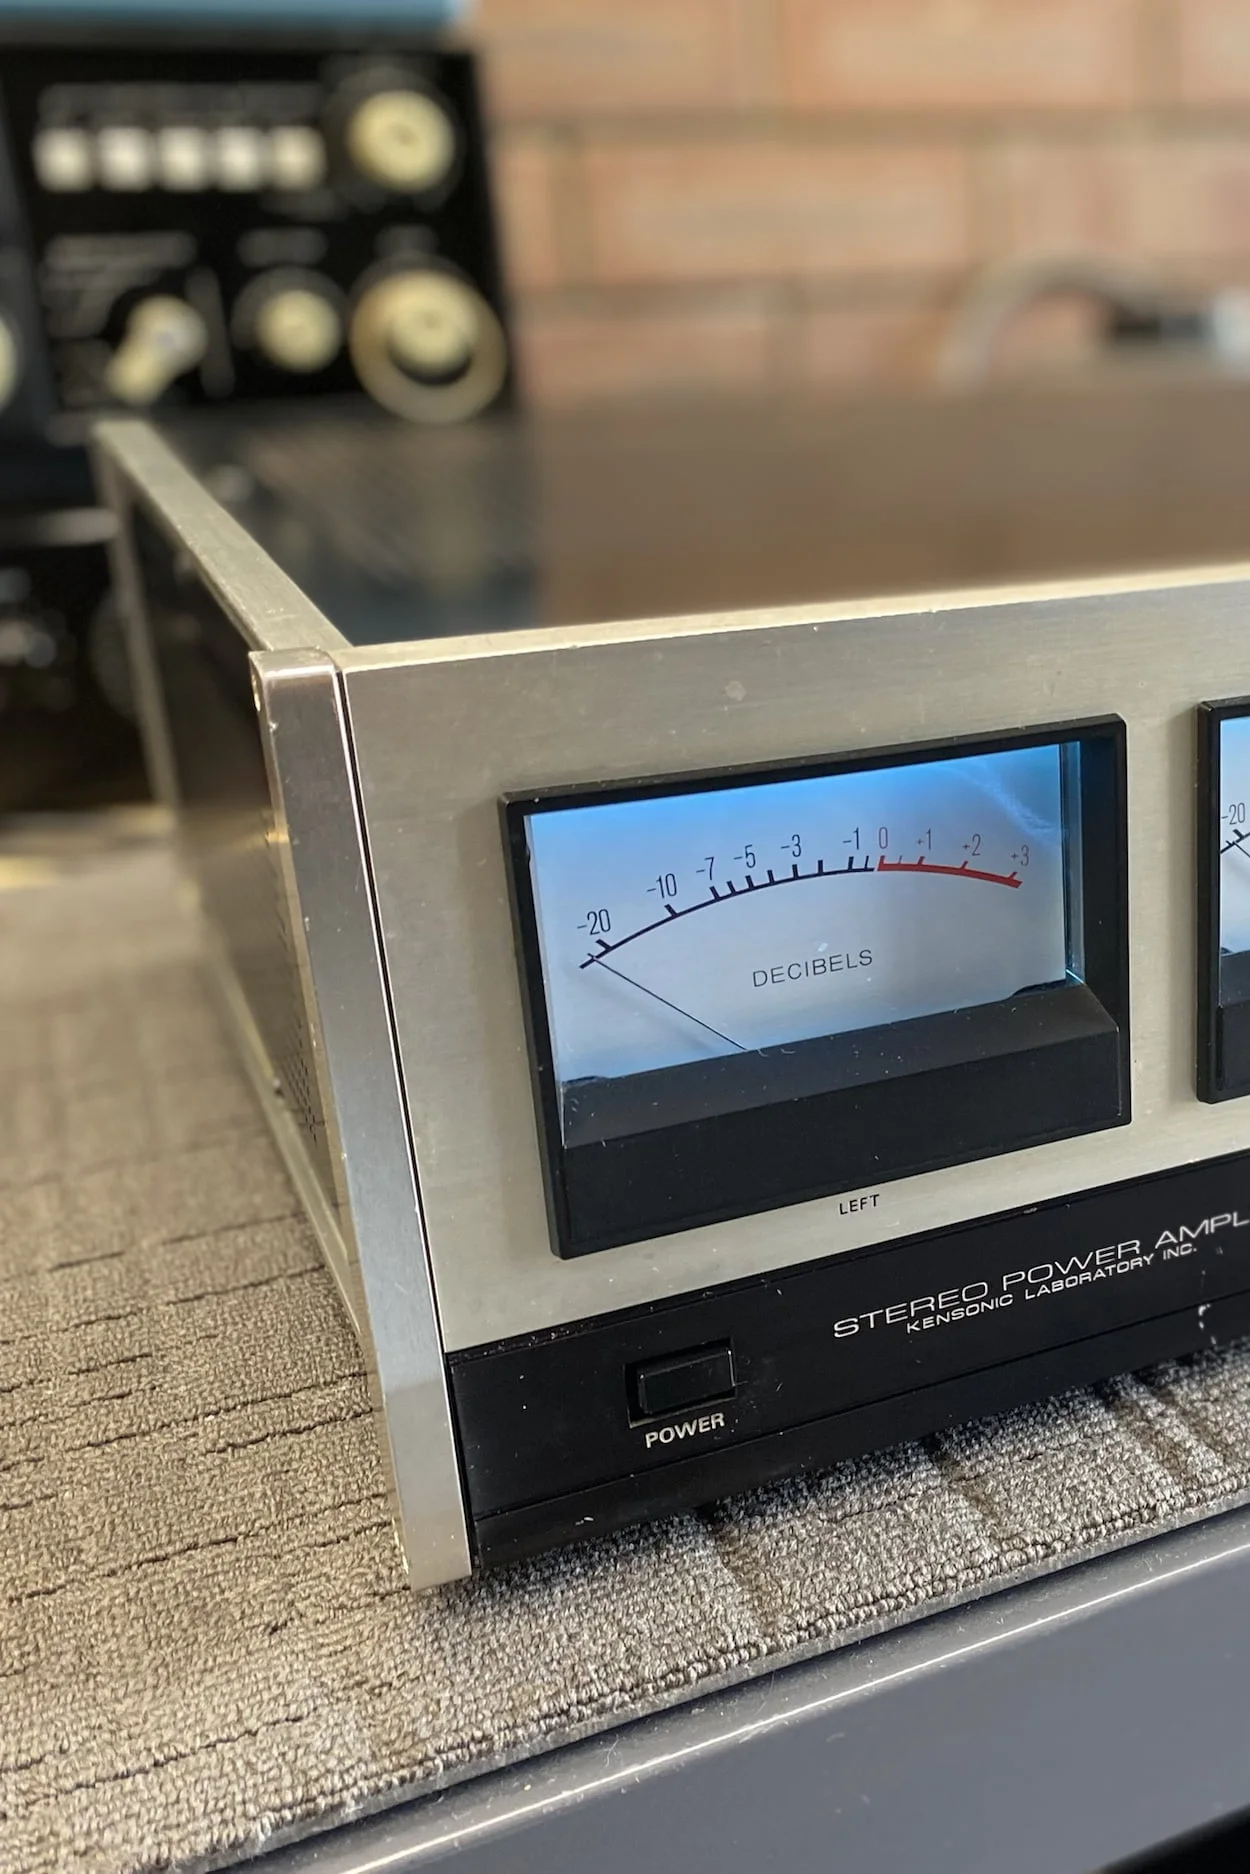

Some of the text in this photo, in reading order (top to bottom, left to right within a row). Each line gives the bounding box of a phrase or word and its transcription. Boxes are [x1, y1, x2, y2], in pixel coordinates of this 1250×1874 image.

[1221, 802, 1246, 826] -20
[577, 826, 1030, 936] -20 -10 -7 -5 -3 -1 0 +1 +2 +3
[752, 949, 874, 988] DECIBELS
[839, 1193, 880, 1215] LEFT
[833, 1281, 989, 1338] STEREO
[1003, 1239, 1140, 1291] POWER
[906, 1242, 1197, 1334] KENSONIC LABORATORY INC.
[645, 1412, 726, 1449] POWER
